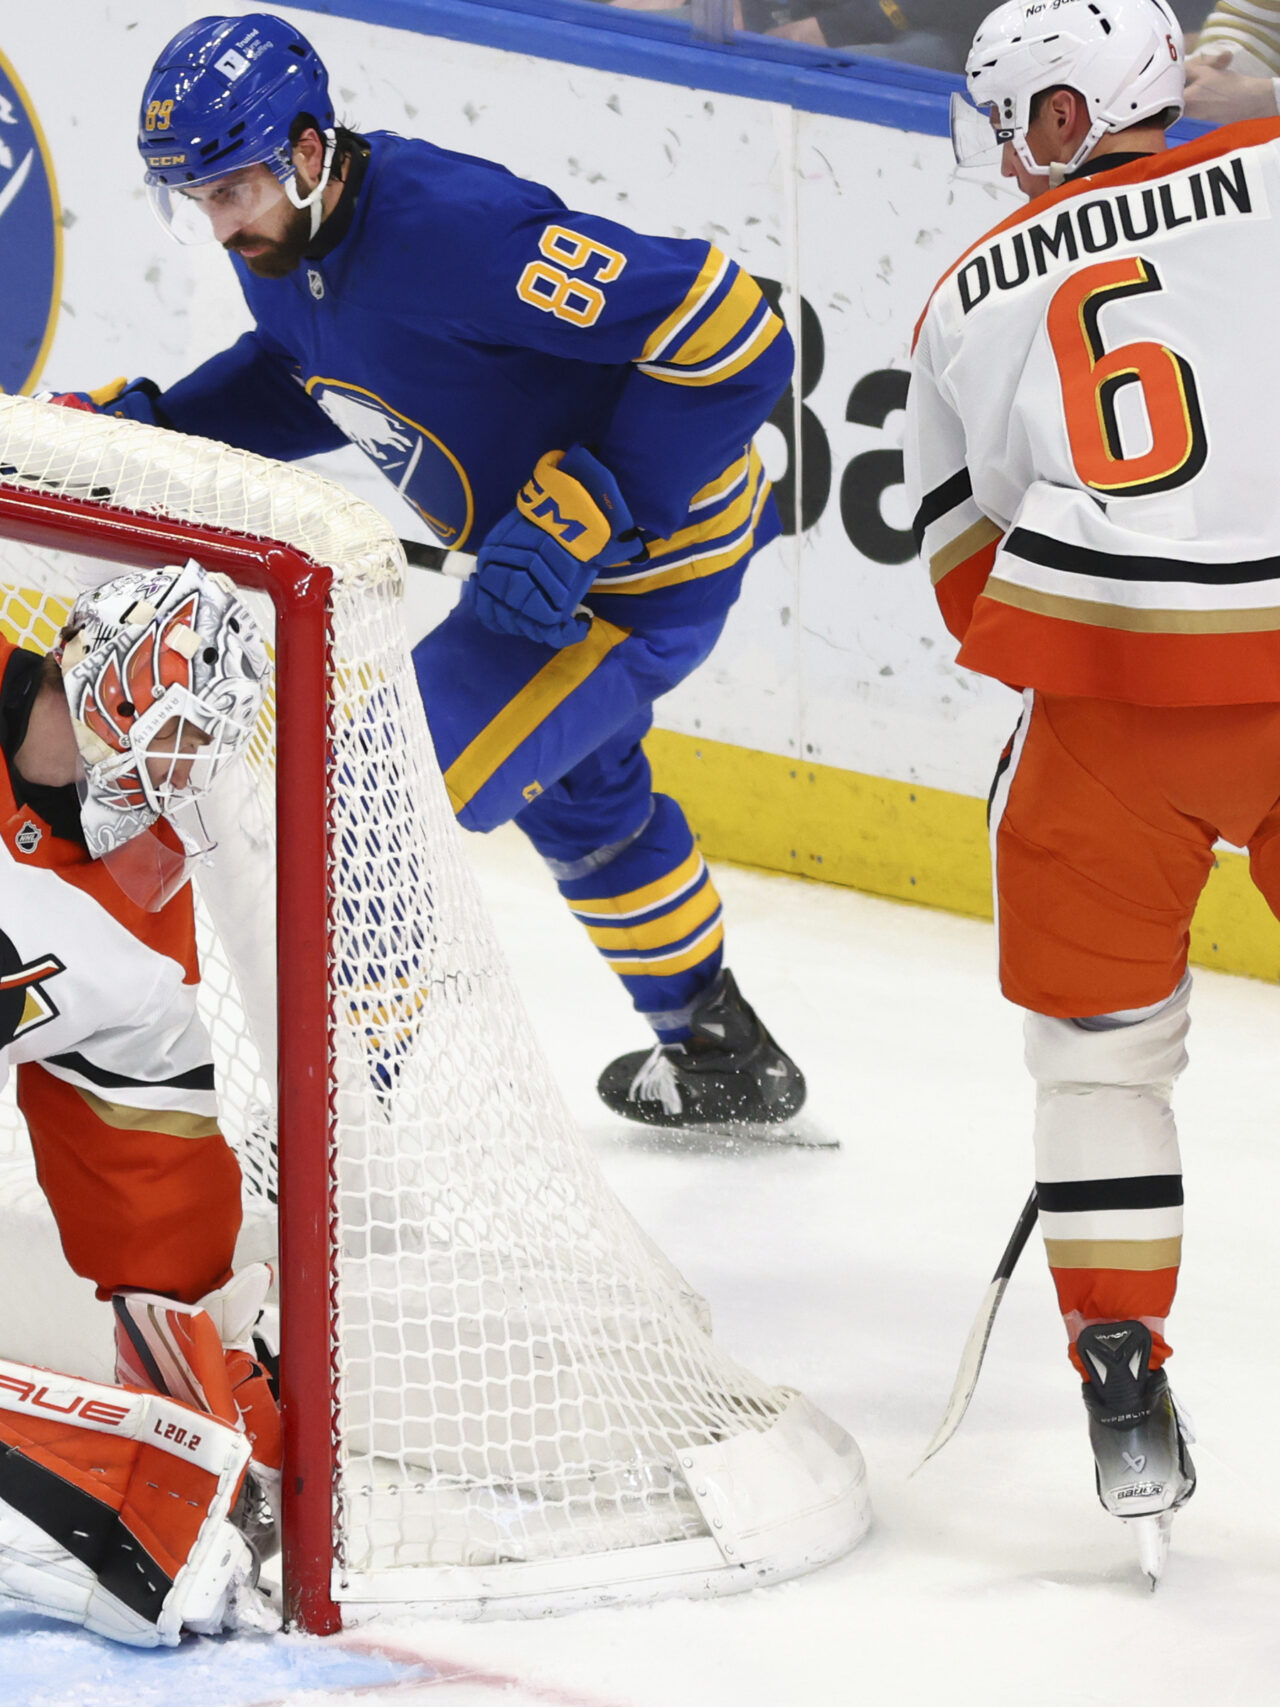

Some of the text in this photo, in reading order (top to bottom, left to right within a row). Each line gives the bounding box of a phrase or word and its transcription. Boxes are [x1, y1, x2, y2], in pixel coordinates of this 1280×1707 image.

[1165, 34, 1177, 61] 6
[145, 99, 175, 131] 89
[149, 154, 186, 166] CCM
[956, 158, 1253, 315] DUMOULIN
[517, 224, 627, 328] 89
[1046, 255, 1209, 503] 6
[153, 1417, 202, 1452] L20.2
